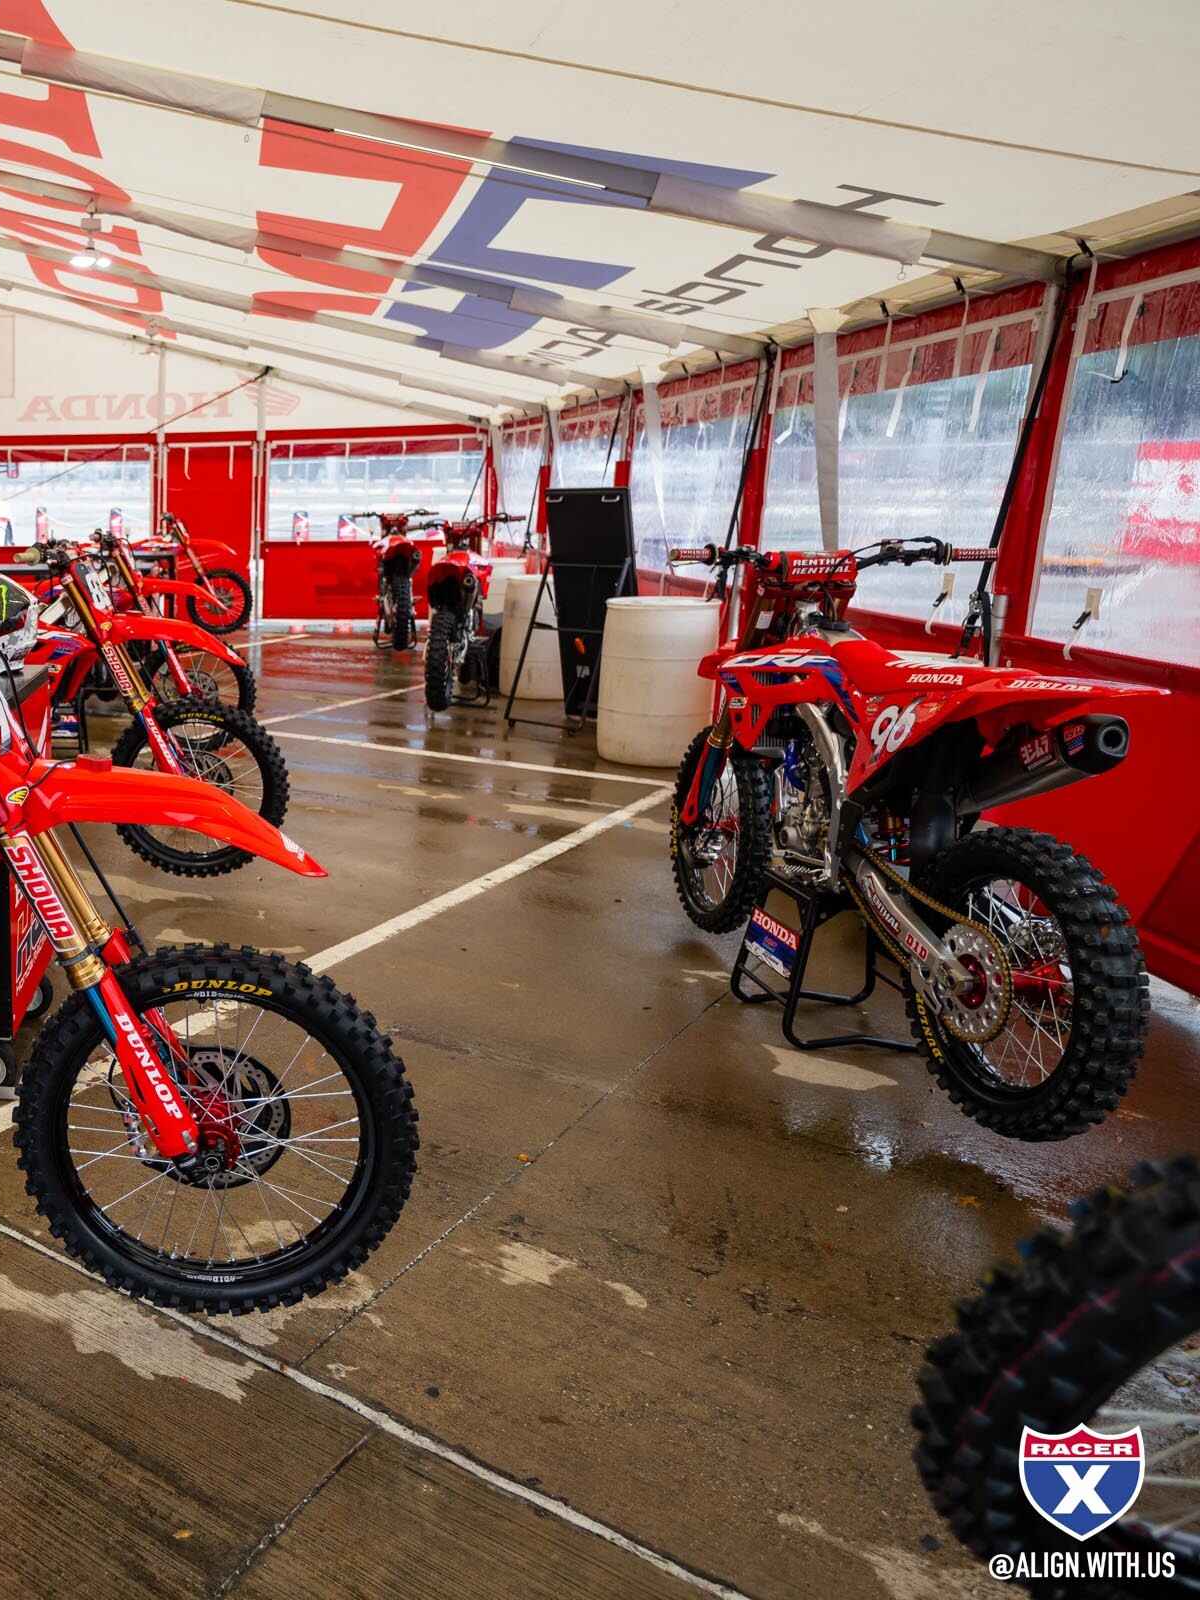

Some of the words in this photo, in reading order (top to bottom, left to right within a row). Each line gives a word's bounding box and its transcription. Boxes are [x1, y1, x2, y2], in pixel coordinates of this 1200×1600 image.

[103, 644, 134, 695] SHOWA
[906, 673, 964, 685] HONDA
[870, 695, 928, 766] 96
[5, 844, 77, 941] SHOWA
[753, 907, 798, 950] HONDA
[173, 979, 273, 996] DUNLOP
[915, 992, 943, 1063] DUNLOP
[115, 1012, 183, 1119] DUNLOP
